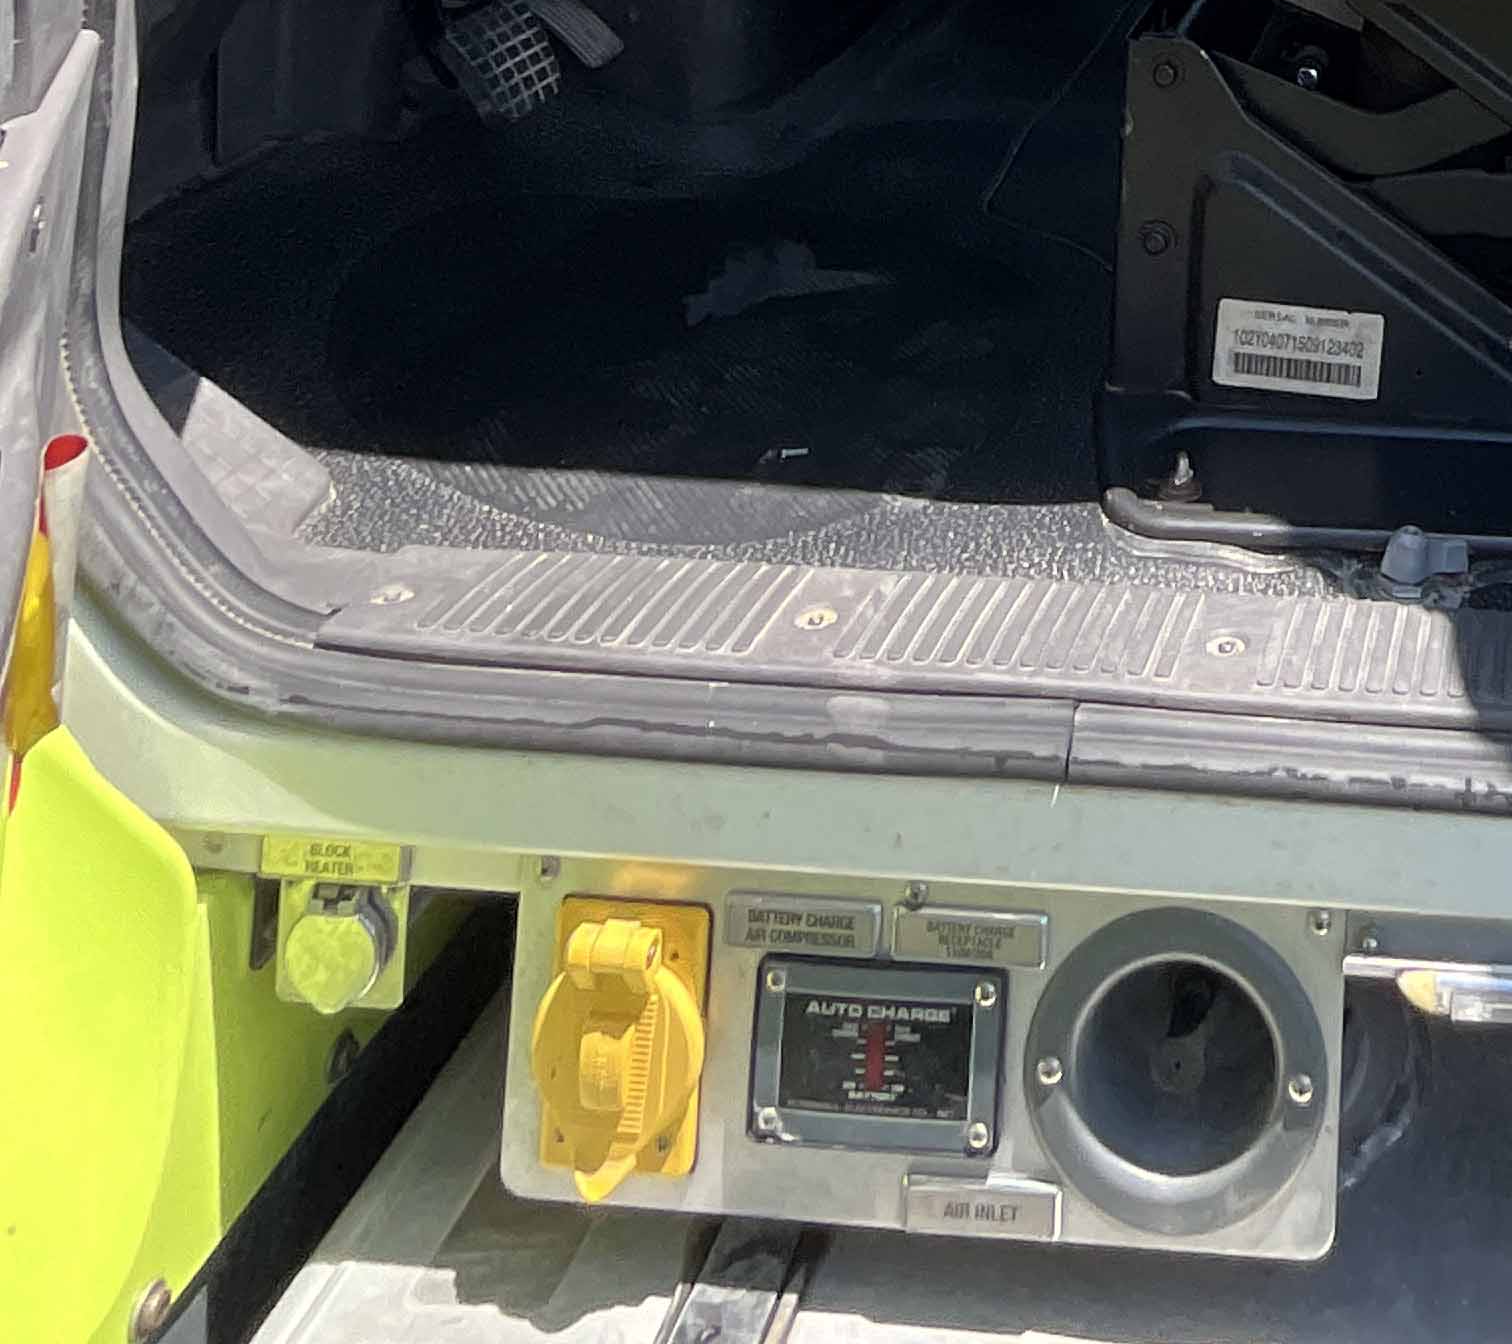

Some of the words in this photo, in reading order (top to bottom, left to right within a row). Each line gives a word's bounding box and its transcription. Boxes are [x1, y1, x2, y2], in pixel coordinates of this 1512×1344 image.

[310, 843, 351, 858] BLOCK
[304, 859, 354, 875] HEATER
[747, 908, 801, 927] BATTERY
[805, 912, 855, 930] CHARGE
[744, 927, 767, 943] AIR
[769, 927, 856, 948] COMPRESSOR
[805, 1000, 862, 1017] AUTO
[866, 1005, 951, 1023] CHARGE
[943, 1201, 970, 1218] AIR
[974, 1203, 1018, 1223] INLET
